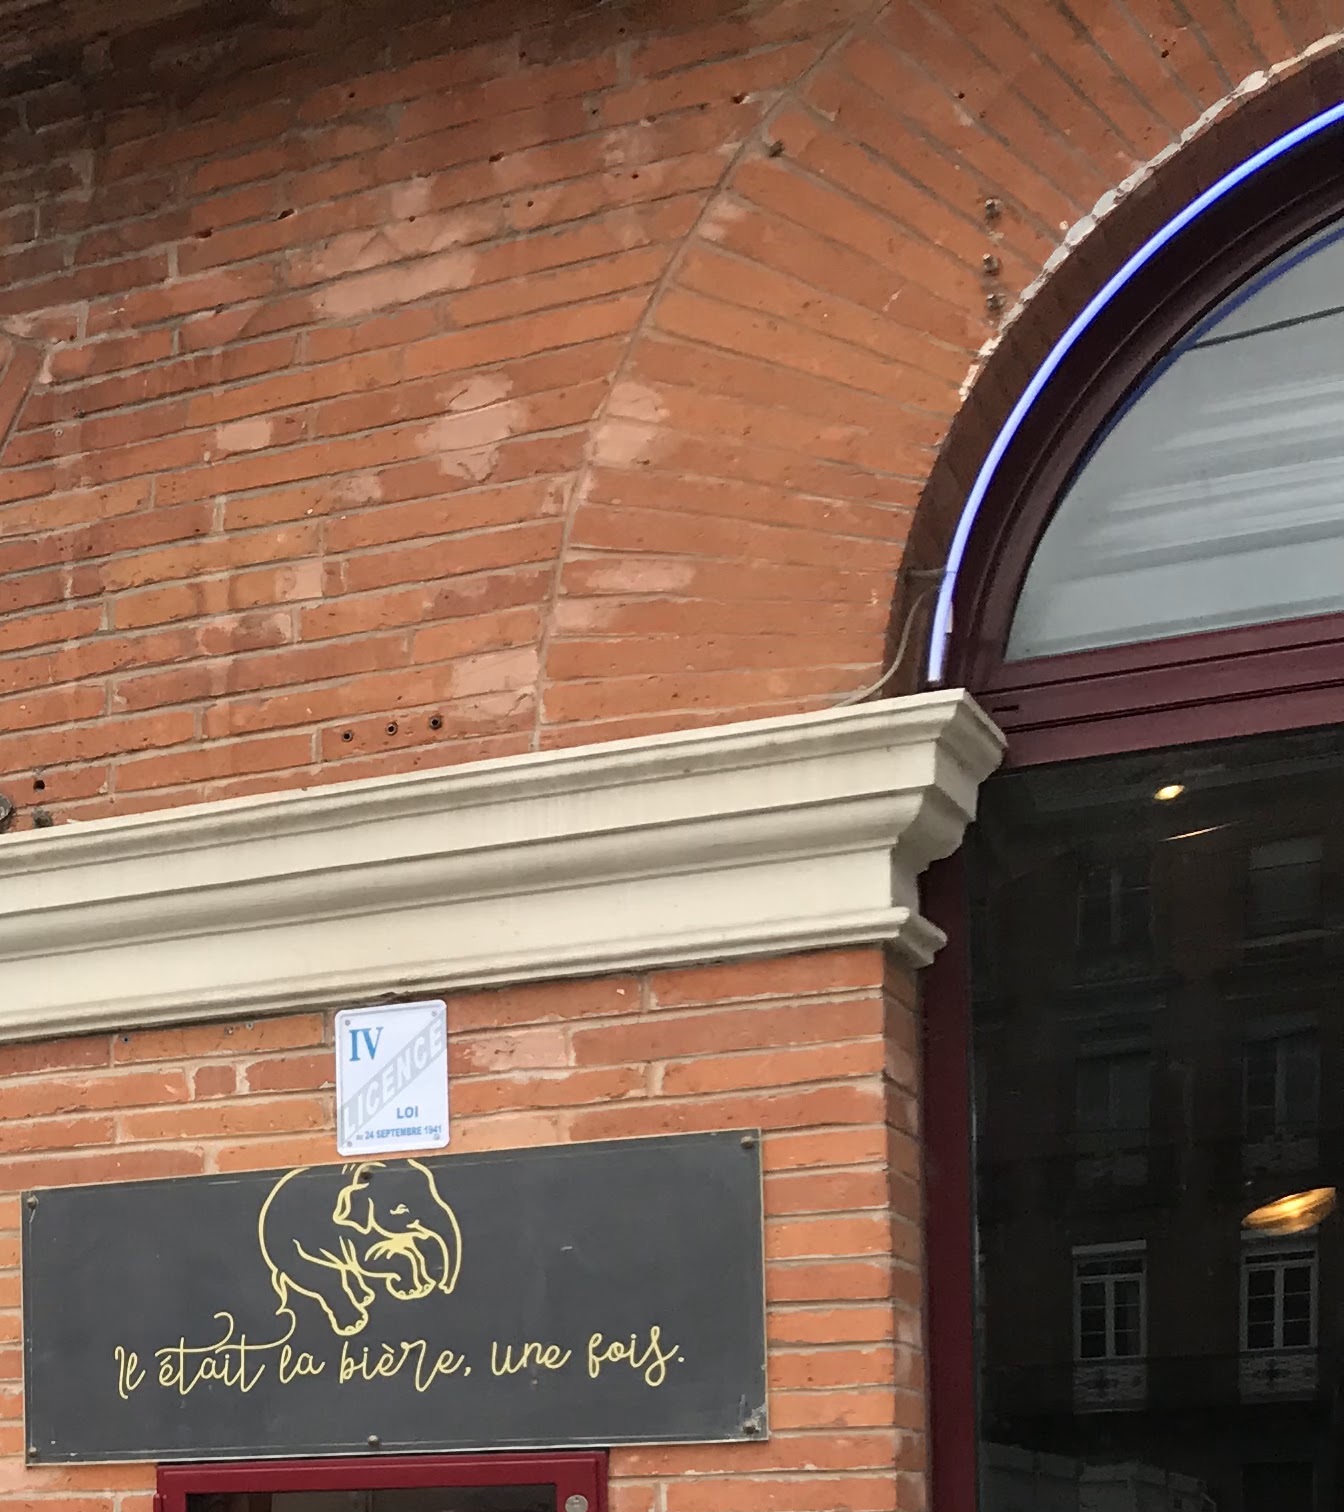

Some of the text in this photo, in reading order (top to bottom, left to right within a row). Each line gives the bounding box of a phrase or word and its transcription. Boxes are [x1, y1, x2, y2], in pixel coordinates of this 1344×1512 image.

[349, 1026, 384, 1062] IV
[343, 1018, 443, 1139] LICENCE
[396, 1106, 419, 1119] LOI
[365, 1130, 375, 1140] 24
[376, 1126, 422, 1138] SEPTEMBRE
[424, 1125, 442, 1134] 1941
[114, 1310, 685, 1399] Il était la bière, une fois.
